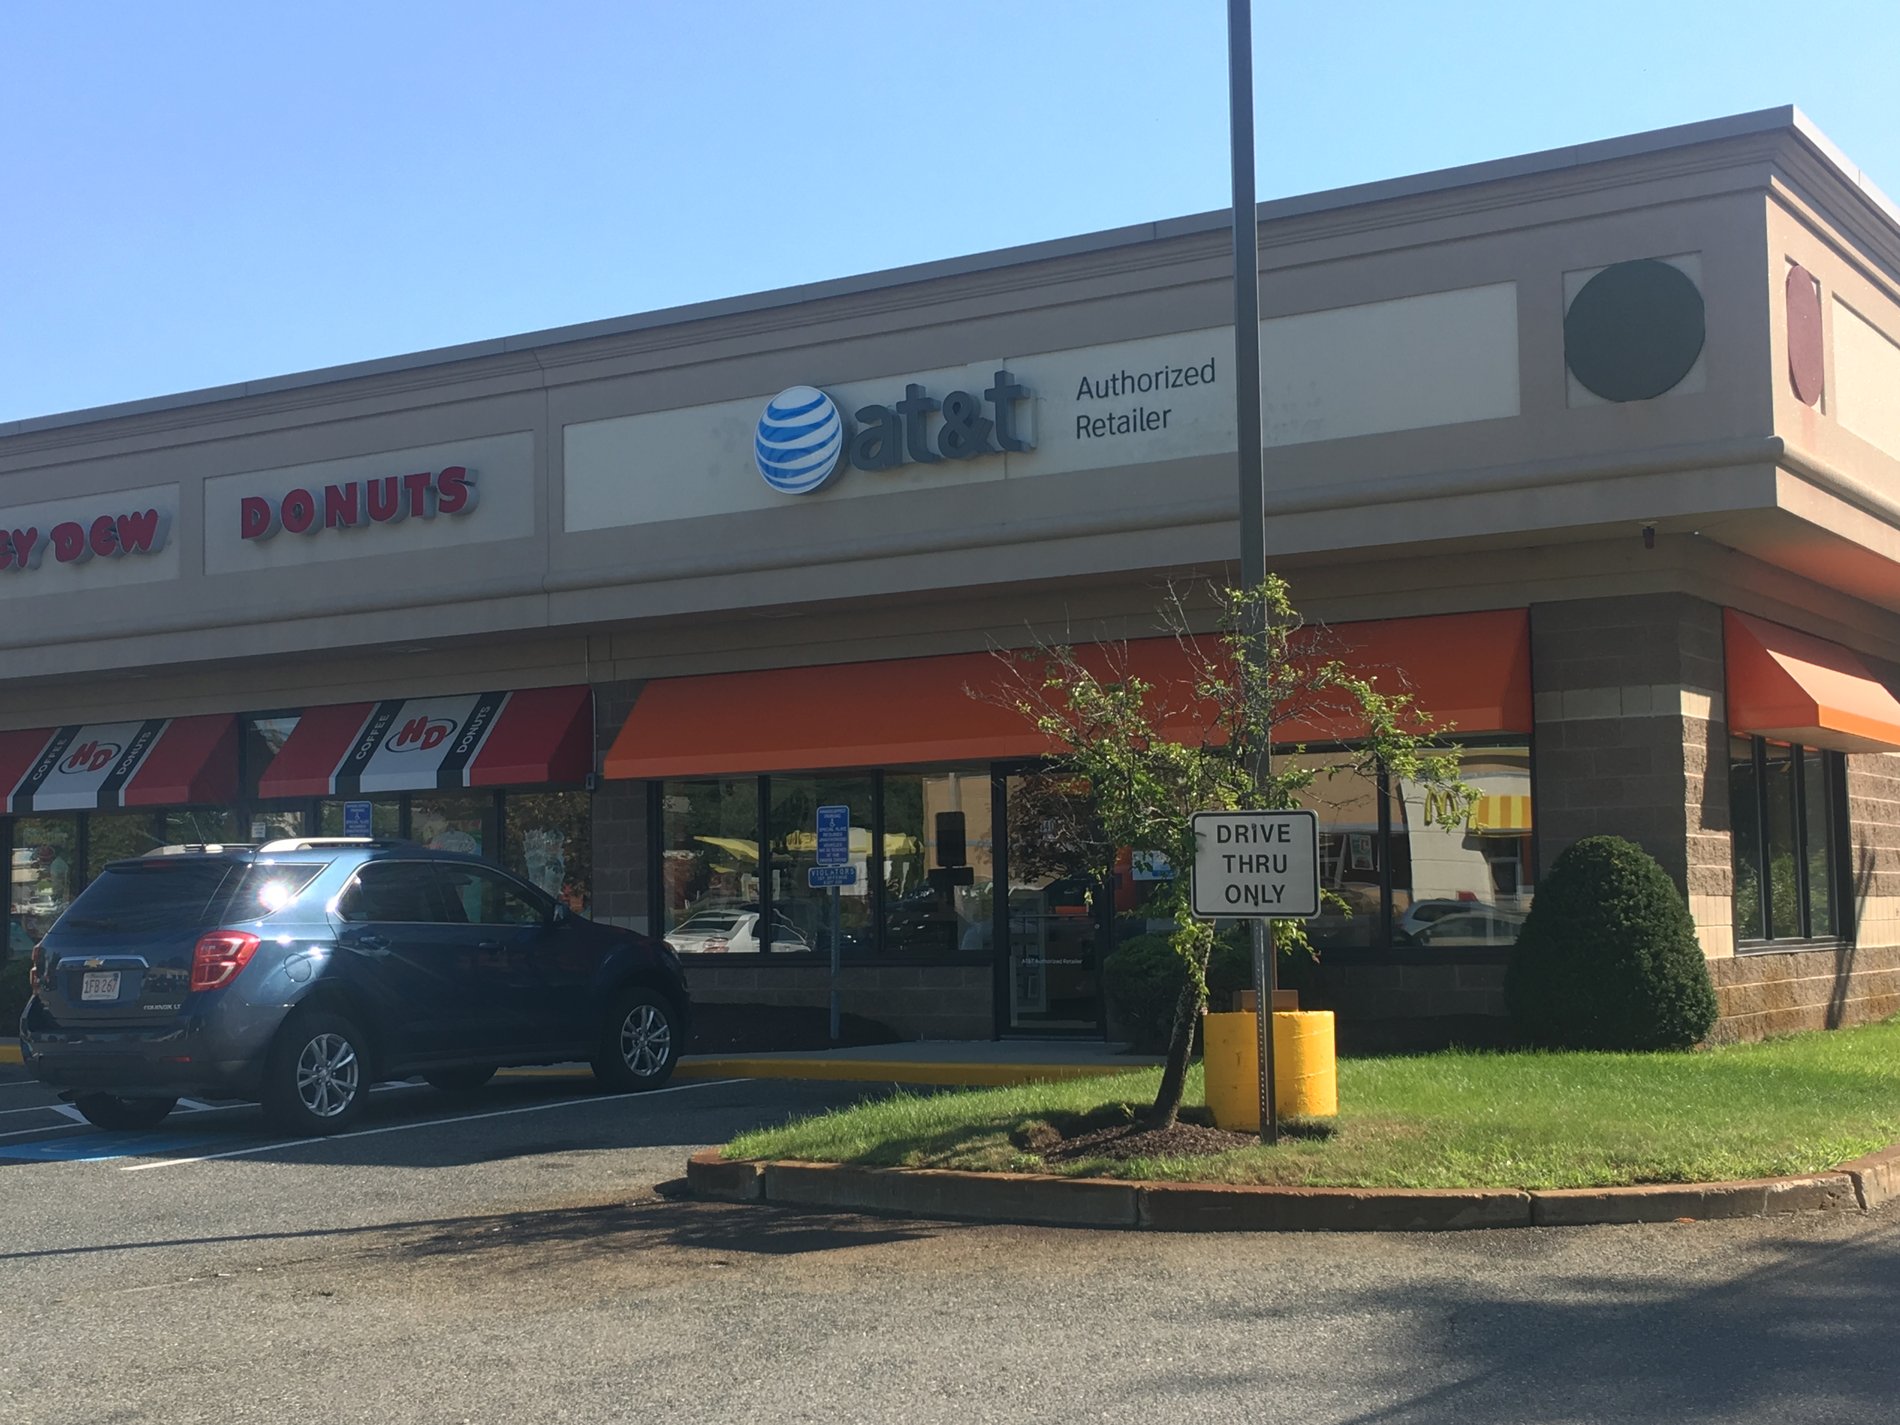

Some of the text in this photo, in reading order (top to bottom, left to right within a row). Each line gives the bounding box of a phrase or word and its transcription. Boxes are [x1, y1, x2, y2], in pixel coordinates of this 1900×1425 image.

[1076, 357, 1216, 401] Authorized
[850, 370, 1036, 472] at&t
[1076, 406, 1172, 440] Retailer
[240, 466, 472, 541] DONUTS
[50, 508, 159, 564] DEW
[356, 714, 390, 760] COFFEE
[396, 716, 448, 750] HD
[456, 705, 491, 753] DONUTS
[32, 738, 68, 781] COFFEE
[67, 740, 113, 772] HD
[116, 731, 152, 775] DONUTS
[1217, 824, 1291, 843] DRIVE
[811, 868, 855, 877] VIOLATORS
[1222, 854, 1287, 873] THRU
[1225, 884, 1285, 904] ONLY
[83, 979, 99, 994] 1FB
